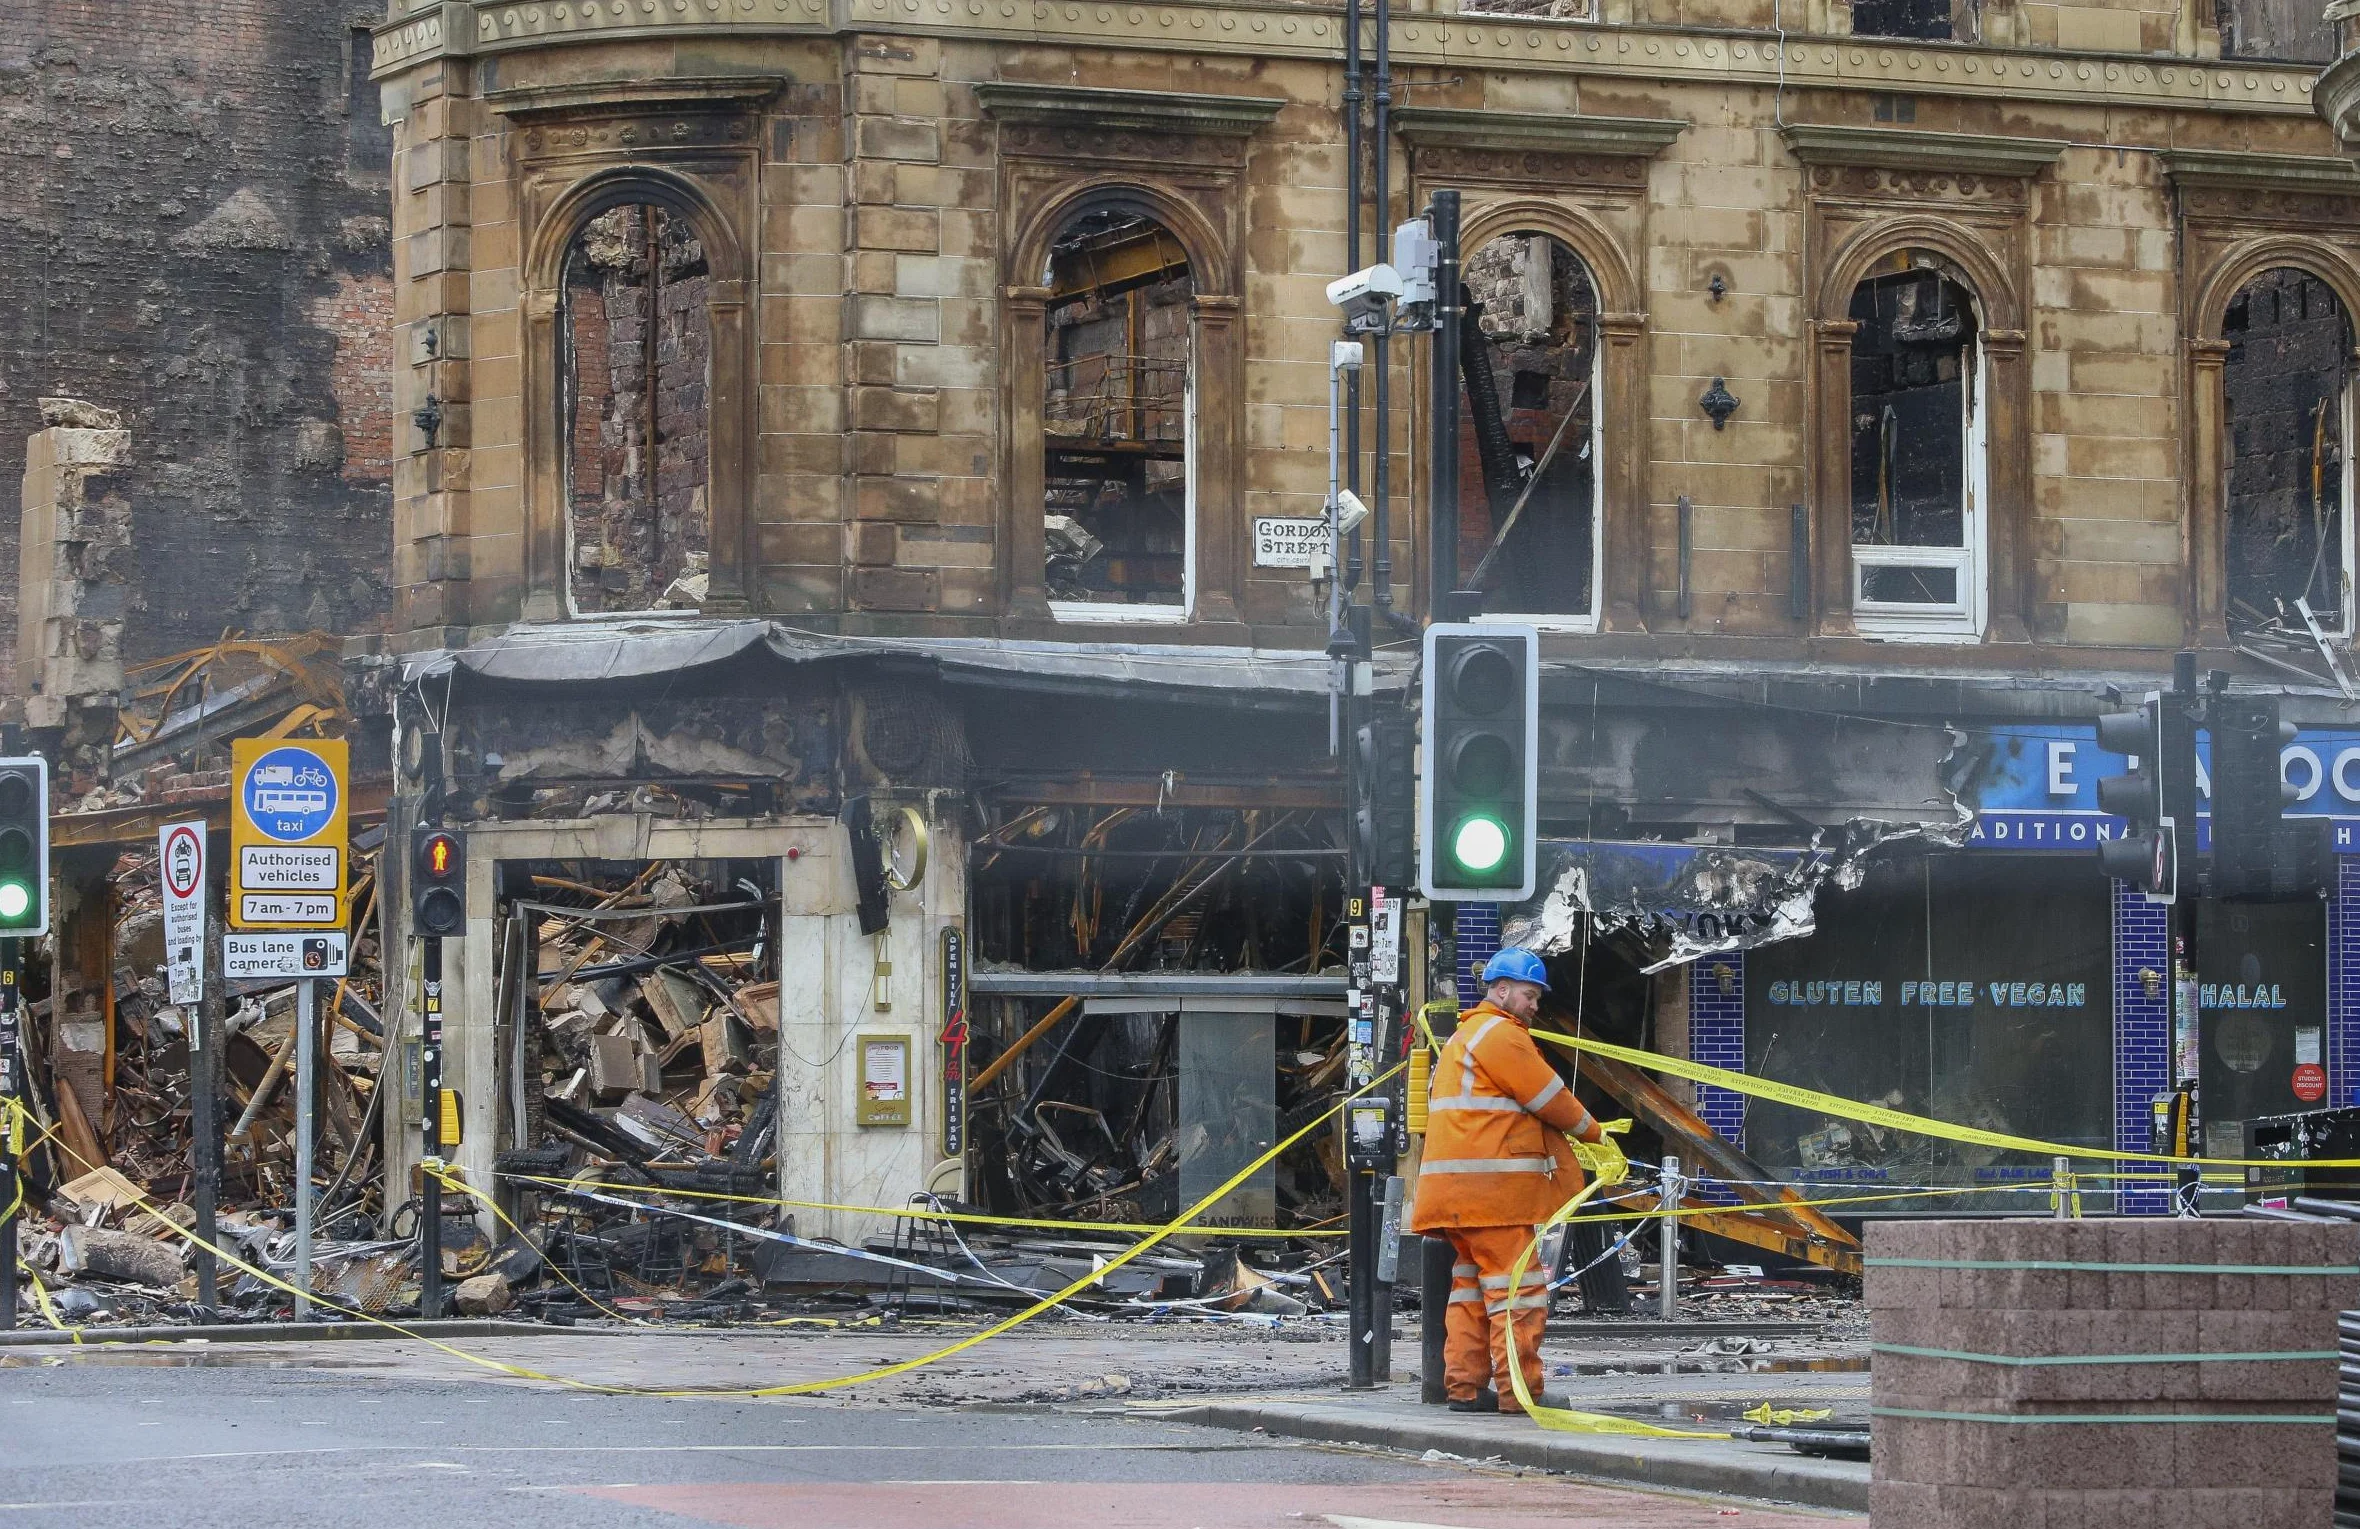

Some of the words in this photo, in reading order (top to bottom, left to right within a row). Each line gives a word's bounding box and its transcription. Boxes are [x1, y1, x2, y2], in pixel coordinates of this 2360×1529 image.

[1258, 521, 1331, 538] GORDON
[1261, 539, 1330, 554] STREET
[276, 819, 303, 832] taxi
[248, 853, 331, 866] Authorised
[258, 869, 320, 882] vehicles
[171, 902, 189, 912] Except
[189, 901, 198, 910] for
[248, 901, 257, 914] 7
[260, 904, 282, 914] am
[294, 902, 303, 914] 7
[306, 904, 329, 916] pm
[1352, 899, 1359, 915] 9
[1392, 899, 1398, 910] by
[171, 912, 198, 923] authorised
[177, 925, 192, 933] buses
[168, 938, 176, 946] and
[177, 934, 195, 945] loading
[196, 933, 202, 943] by
[229, 941, 257, 953] Bus
[263, 941, 295, 953] lane
[949, 936, 957, 968] OPEN
[4, 972, 12, 984] 6
[949, 974, 957, 1007] TILL
[1768, 980, 1882, 1006] GLUTEN
[1901, 981, 1975, 1006] FREE
[1989, 982, 2085, 1007] VEGAN
[2200, 983, 2287, 1009] HALAL
[428, 998, 437, 1010] 7
[939, 1010, 968, 1058] 4
